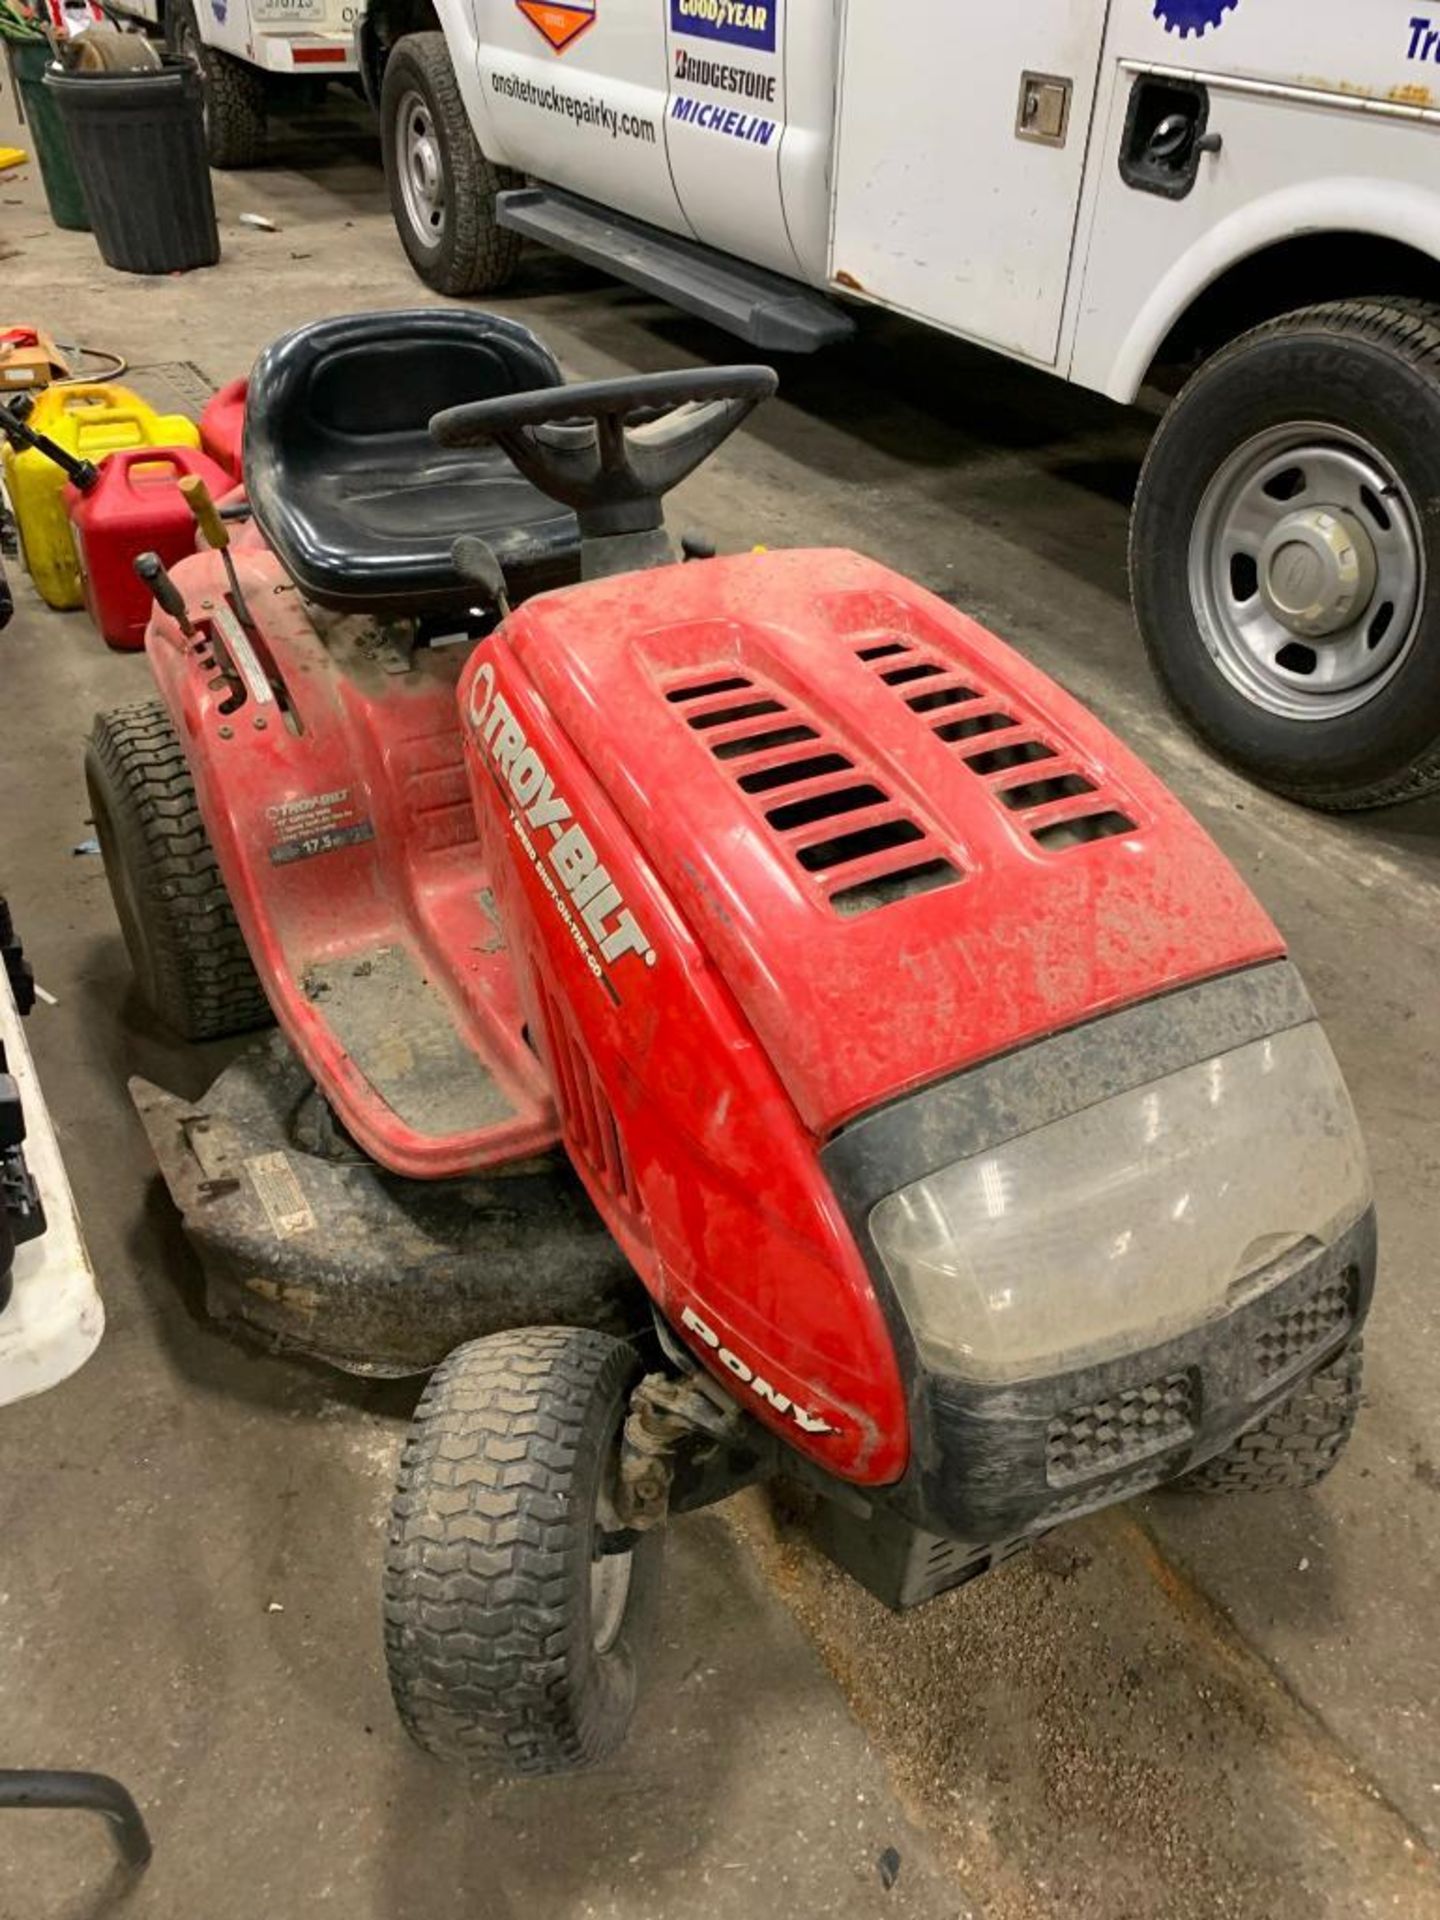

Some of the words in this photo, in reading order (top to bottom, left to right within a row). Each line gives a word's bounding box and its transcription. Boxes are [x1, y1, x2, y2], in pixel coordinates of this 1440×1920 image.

[491, 71, 656, 144] onsitetruckrepairky.com
[675, 50, 776, 102] BRIDGESTONE
[671, 97, 776, 146] MICHELIN
[484, 691, 650, 965] TROY-BILT
[681, 1305, 834, 1433] PONY
